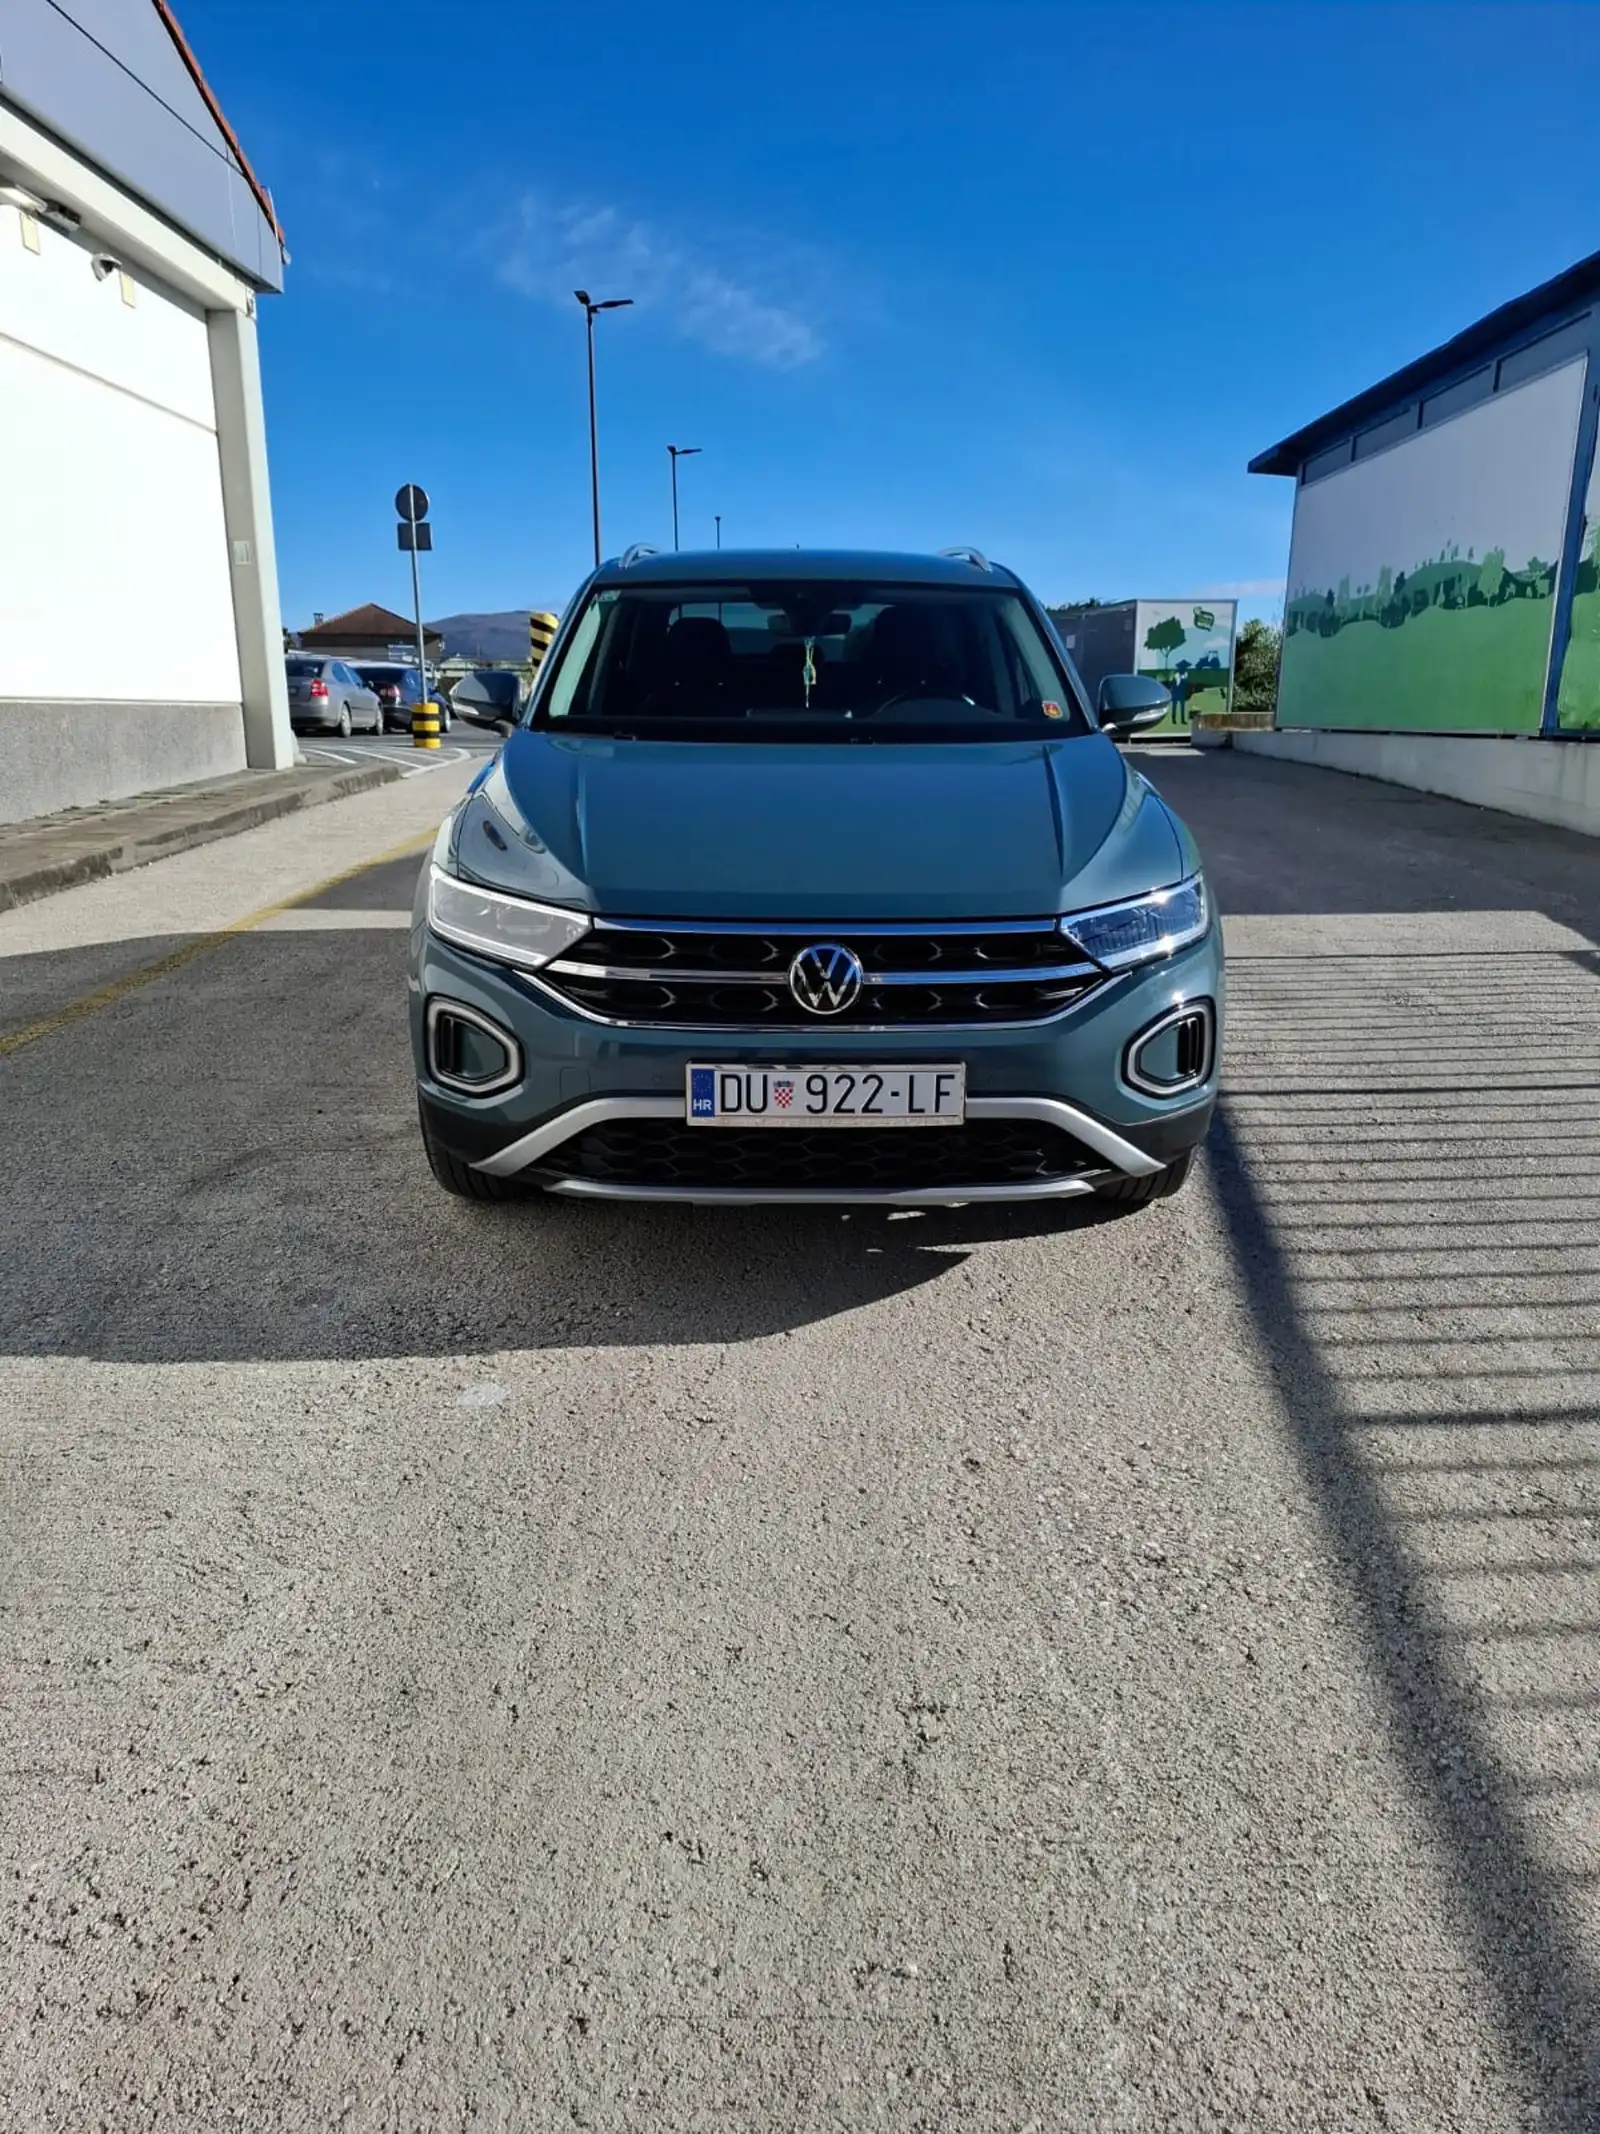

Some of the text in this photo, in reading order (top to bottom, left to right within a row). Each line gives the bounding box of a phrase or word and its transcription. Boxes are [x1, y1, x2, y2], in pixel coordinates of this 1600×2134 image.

[793, 946, 858, 1010] VW
[692, 1098, 712, 1111] HR
[720, 1073, 955, 1113] DU 922-LF
